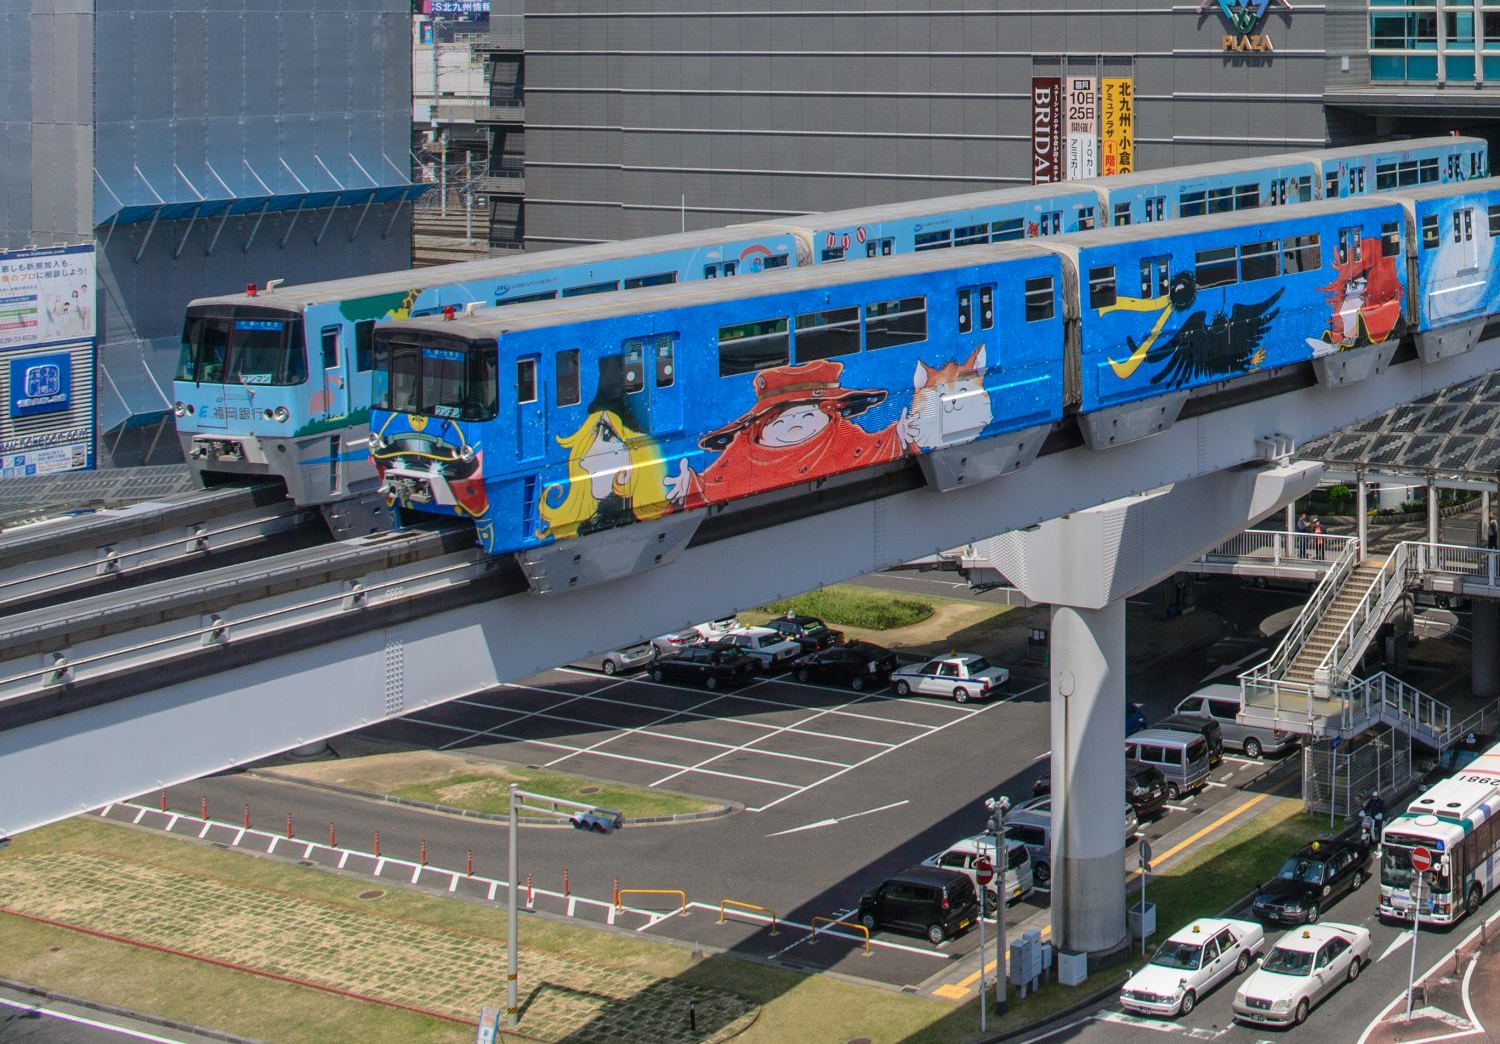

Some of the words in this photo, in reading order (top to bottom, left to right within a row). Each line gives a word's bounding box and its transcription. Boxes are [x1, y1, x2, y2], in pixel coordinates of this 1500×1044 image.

[1222, 34, 1273, 51] PLAZA
[1069, 91, 1094, 105] 10日
[1069, 106, 1094, 120] 25日
[214, 406, 264, 421] 福岡銀行
